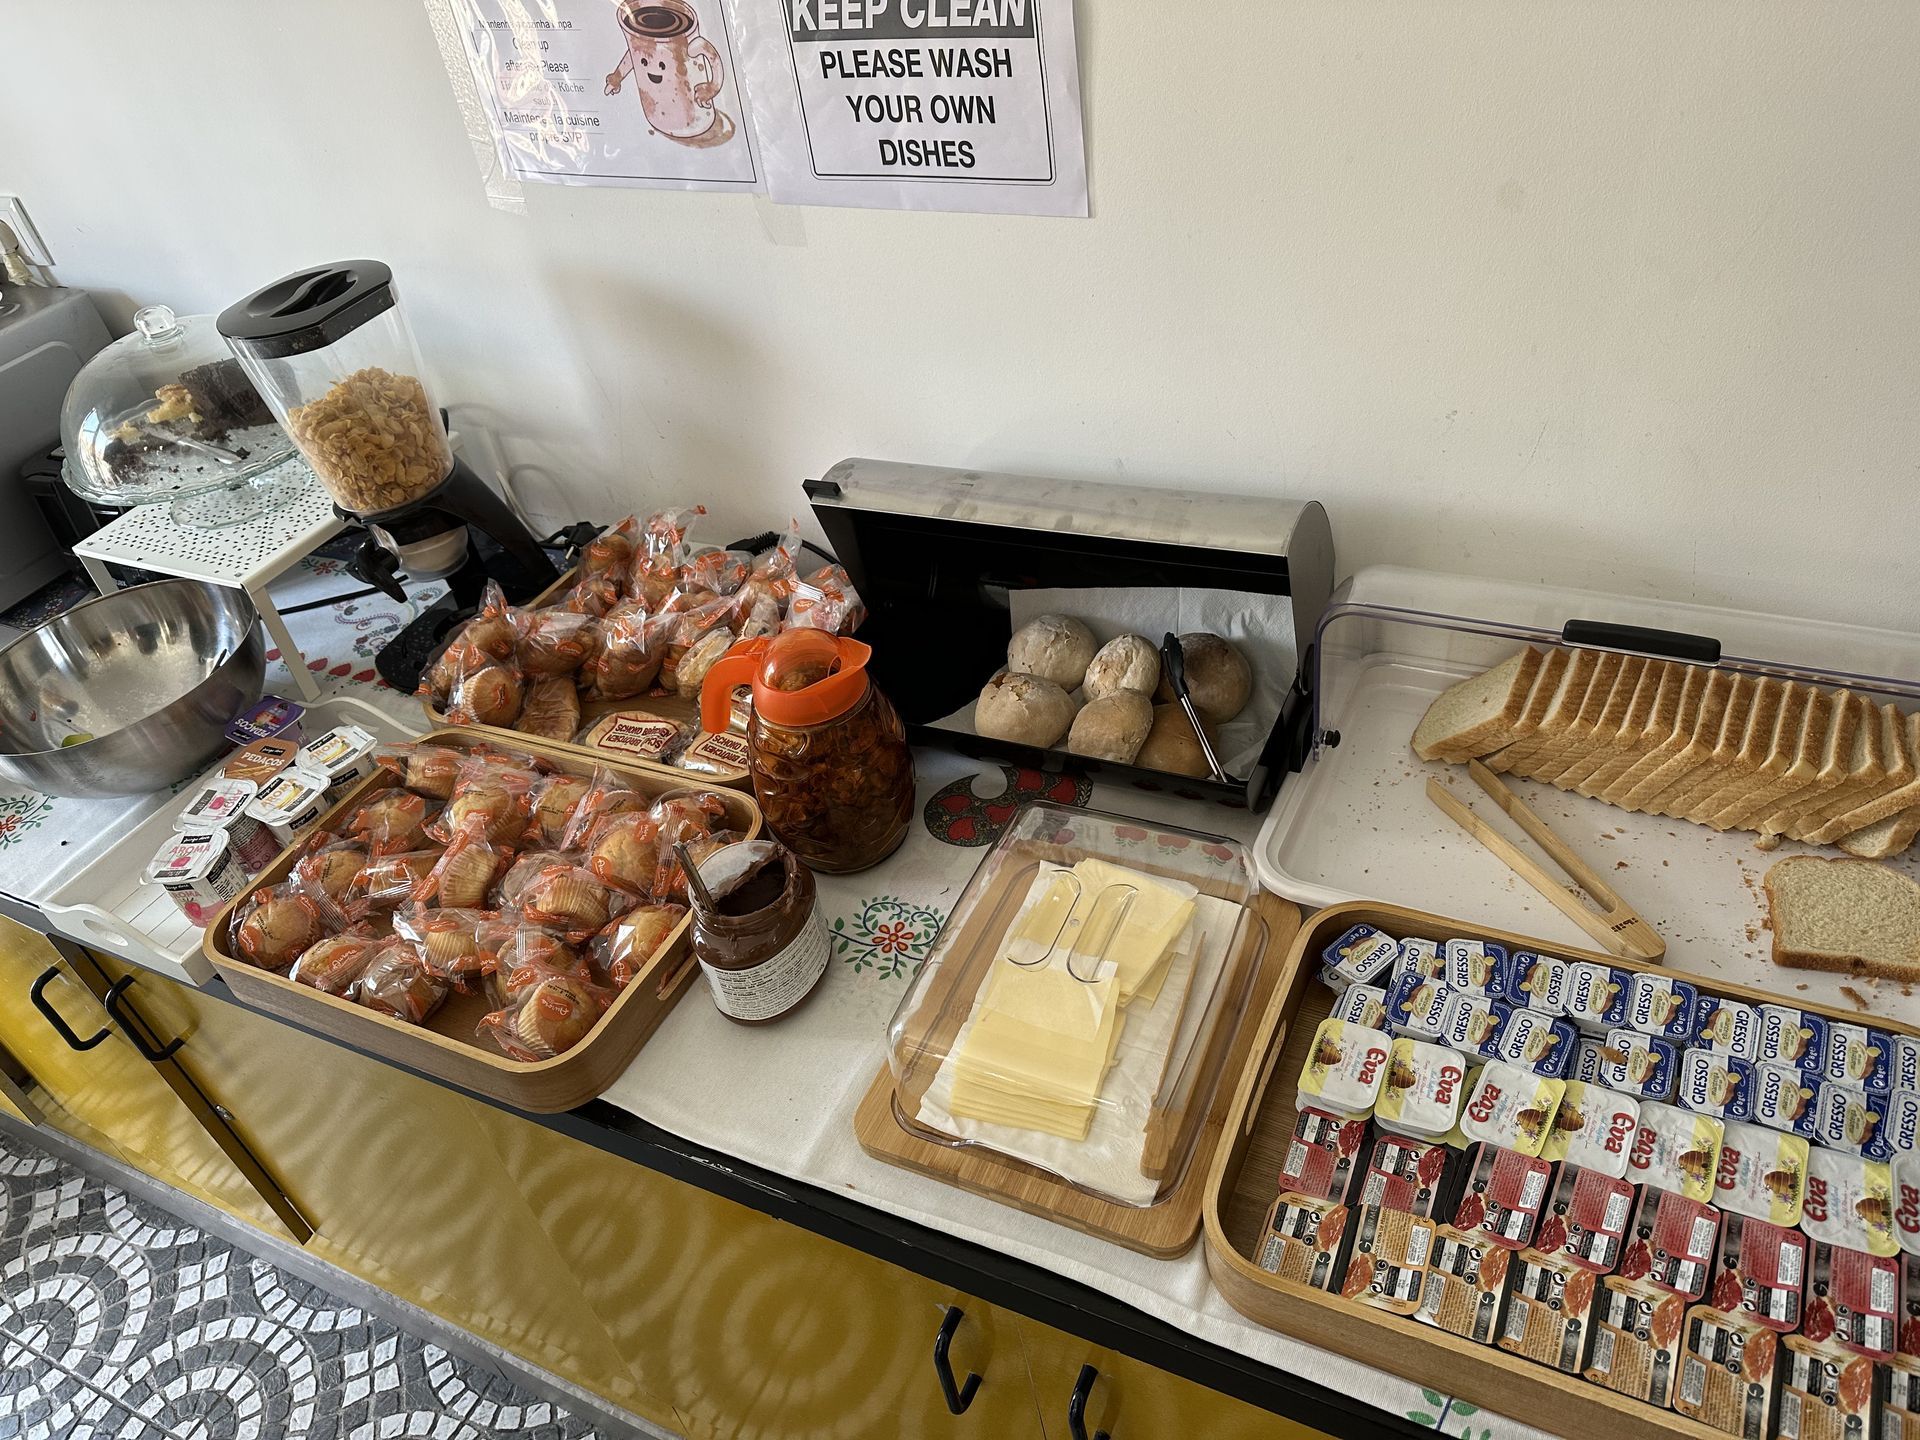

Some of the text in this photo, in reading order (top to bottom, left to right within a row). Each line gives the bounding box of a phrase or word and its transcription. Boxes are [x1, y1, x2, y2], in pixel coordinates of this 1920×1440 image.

[792, 0, 1026, 31] KEEP CLEAN
[542, 60, 570, 73] Please
[820, 48, 1013, 78] PLEASE WASH
[554, 113, 564, 125] la
[567, 113, 600, 126] cuisine
[845, 95, 996, 123] YOUR OWN
[879, 139, 976, 168] DISHES
[241, 752, 285, 766] PEDAÇOS
[712, 735, 742, 749] SCHOKO
[168, 845, 211, 855] AROMA
[1355, 943, 1391, 972] GRESSO
[1405, 947, 1420, 972] ESSO
[1457, 948, 1468, 987] GRESSO
[1547, 965, 1564, 1005] GRESSO
[1574, 971, 1592, 1012] GRESSO
[1635, 983, 1653, 1024] GRESSO
[1347, 993, 1368, 1024] RESSO
[1426, 987, 1449, 1025] GRESSO
[1453, 1002, 1473, 1042] GRESSO
[1508, 1019, 1532, 1059] GRESSO
[1732, 1010, 1749, 1053] GRESSO
[1764, 1015, 1781, 1059] GRESSO
[1358, 1048, 1387, 1085] Eva
[1581, 1048, 1598, 1083] RESSO
[1831, 1034, 1847, 1078] GRESSO
[1435, 1066, 1462, 1105] Eva
[1692, 1059, 1708, 1104] GRESSO
[1762, 1072, 1781, 1118] GRESSO
[1468, 1084, 1502, 1123] Eva
[1829, 1094, 1847, 1141] GRESSO
[1604, 1112, 1636, 1154] Eva
[1899, 1101, 1918, 1150] GRESSO
[1630, 1127, 1658, 1170] Eva
[1717, 1146, 1740, 1190] Eva
[1804, 1176, 1828, 1222] Eva
[1894, 1184, 1920, 1234] Eva
